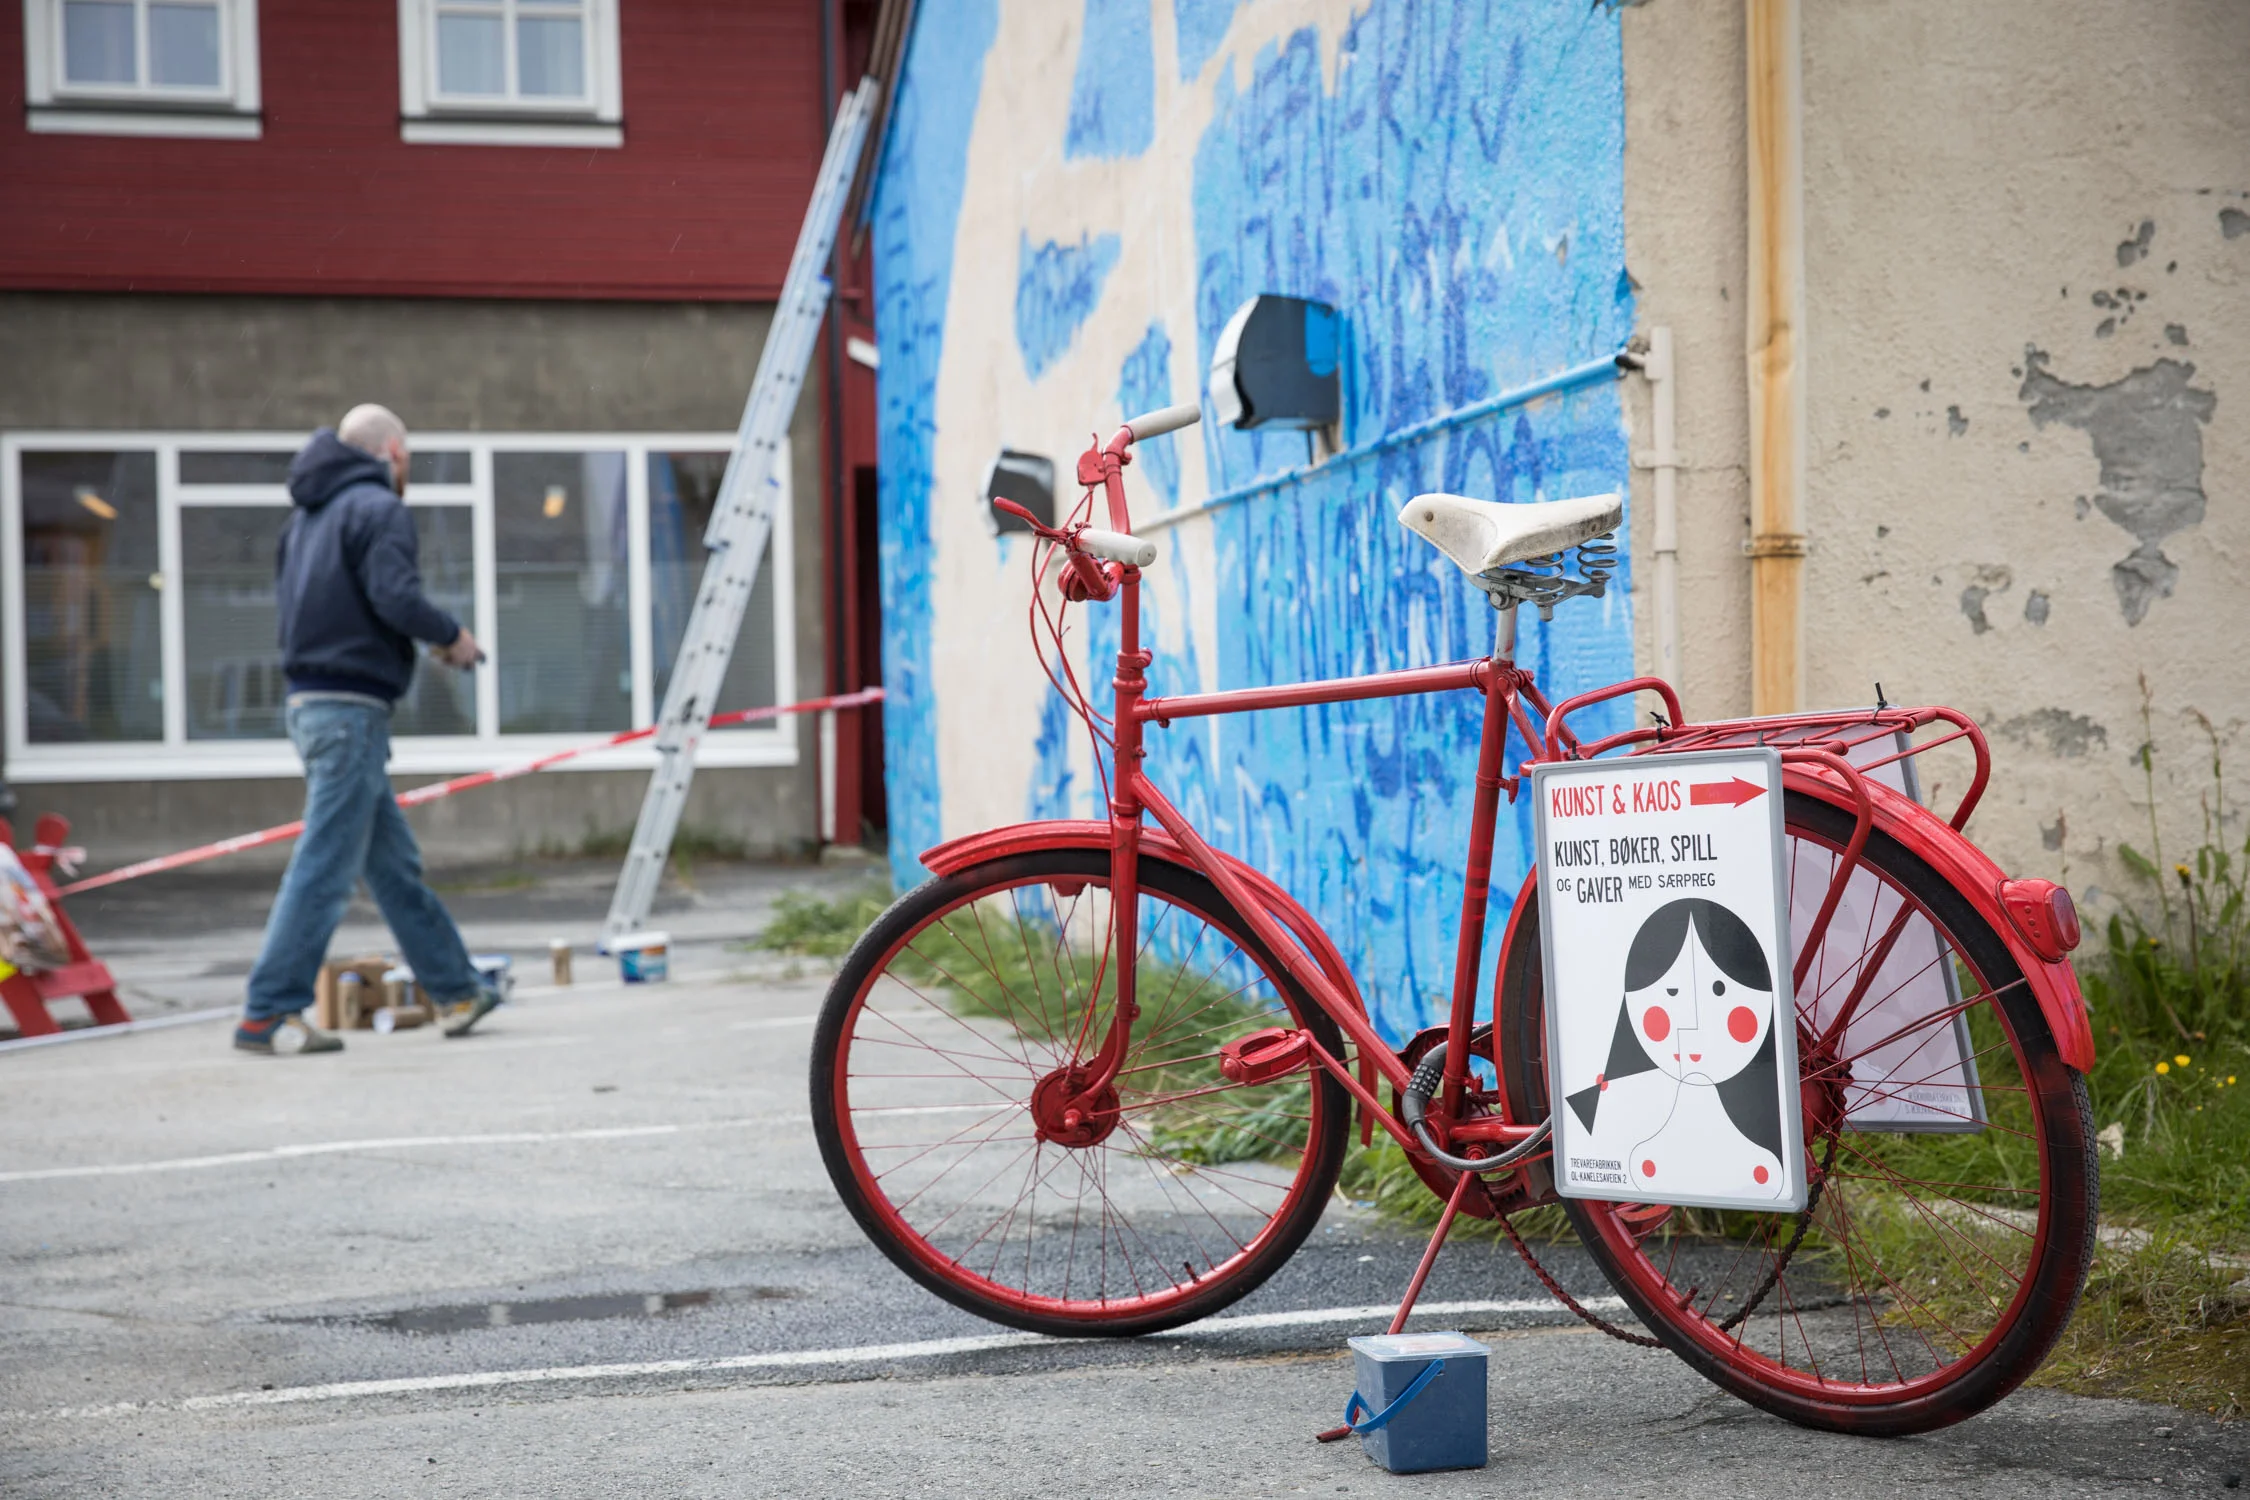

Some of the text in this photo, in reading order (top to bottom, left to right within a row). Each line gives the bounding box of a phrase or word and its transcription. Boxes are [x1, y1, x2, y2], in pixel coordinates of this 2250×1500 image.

[1551, 779, 1682, 818] KUNST & KAOS
[1554, 833, 1718, 867] KUNST, BØKER, SPILL
[1556, 872, 1716, 904] OG GAVER MED SÆRPREG
[1570, 1158, 1621, 1170] TREVAREFABRIKKEN
[1623, 1174, 1628, 1184] 2
